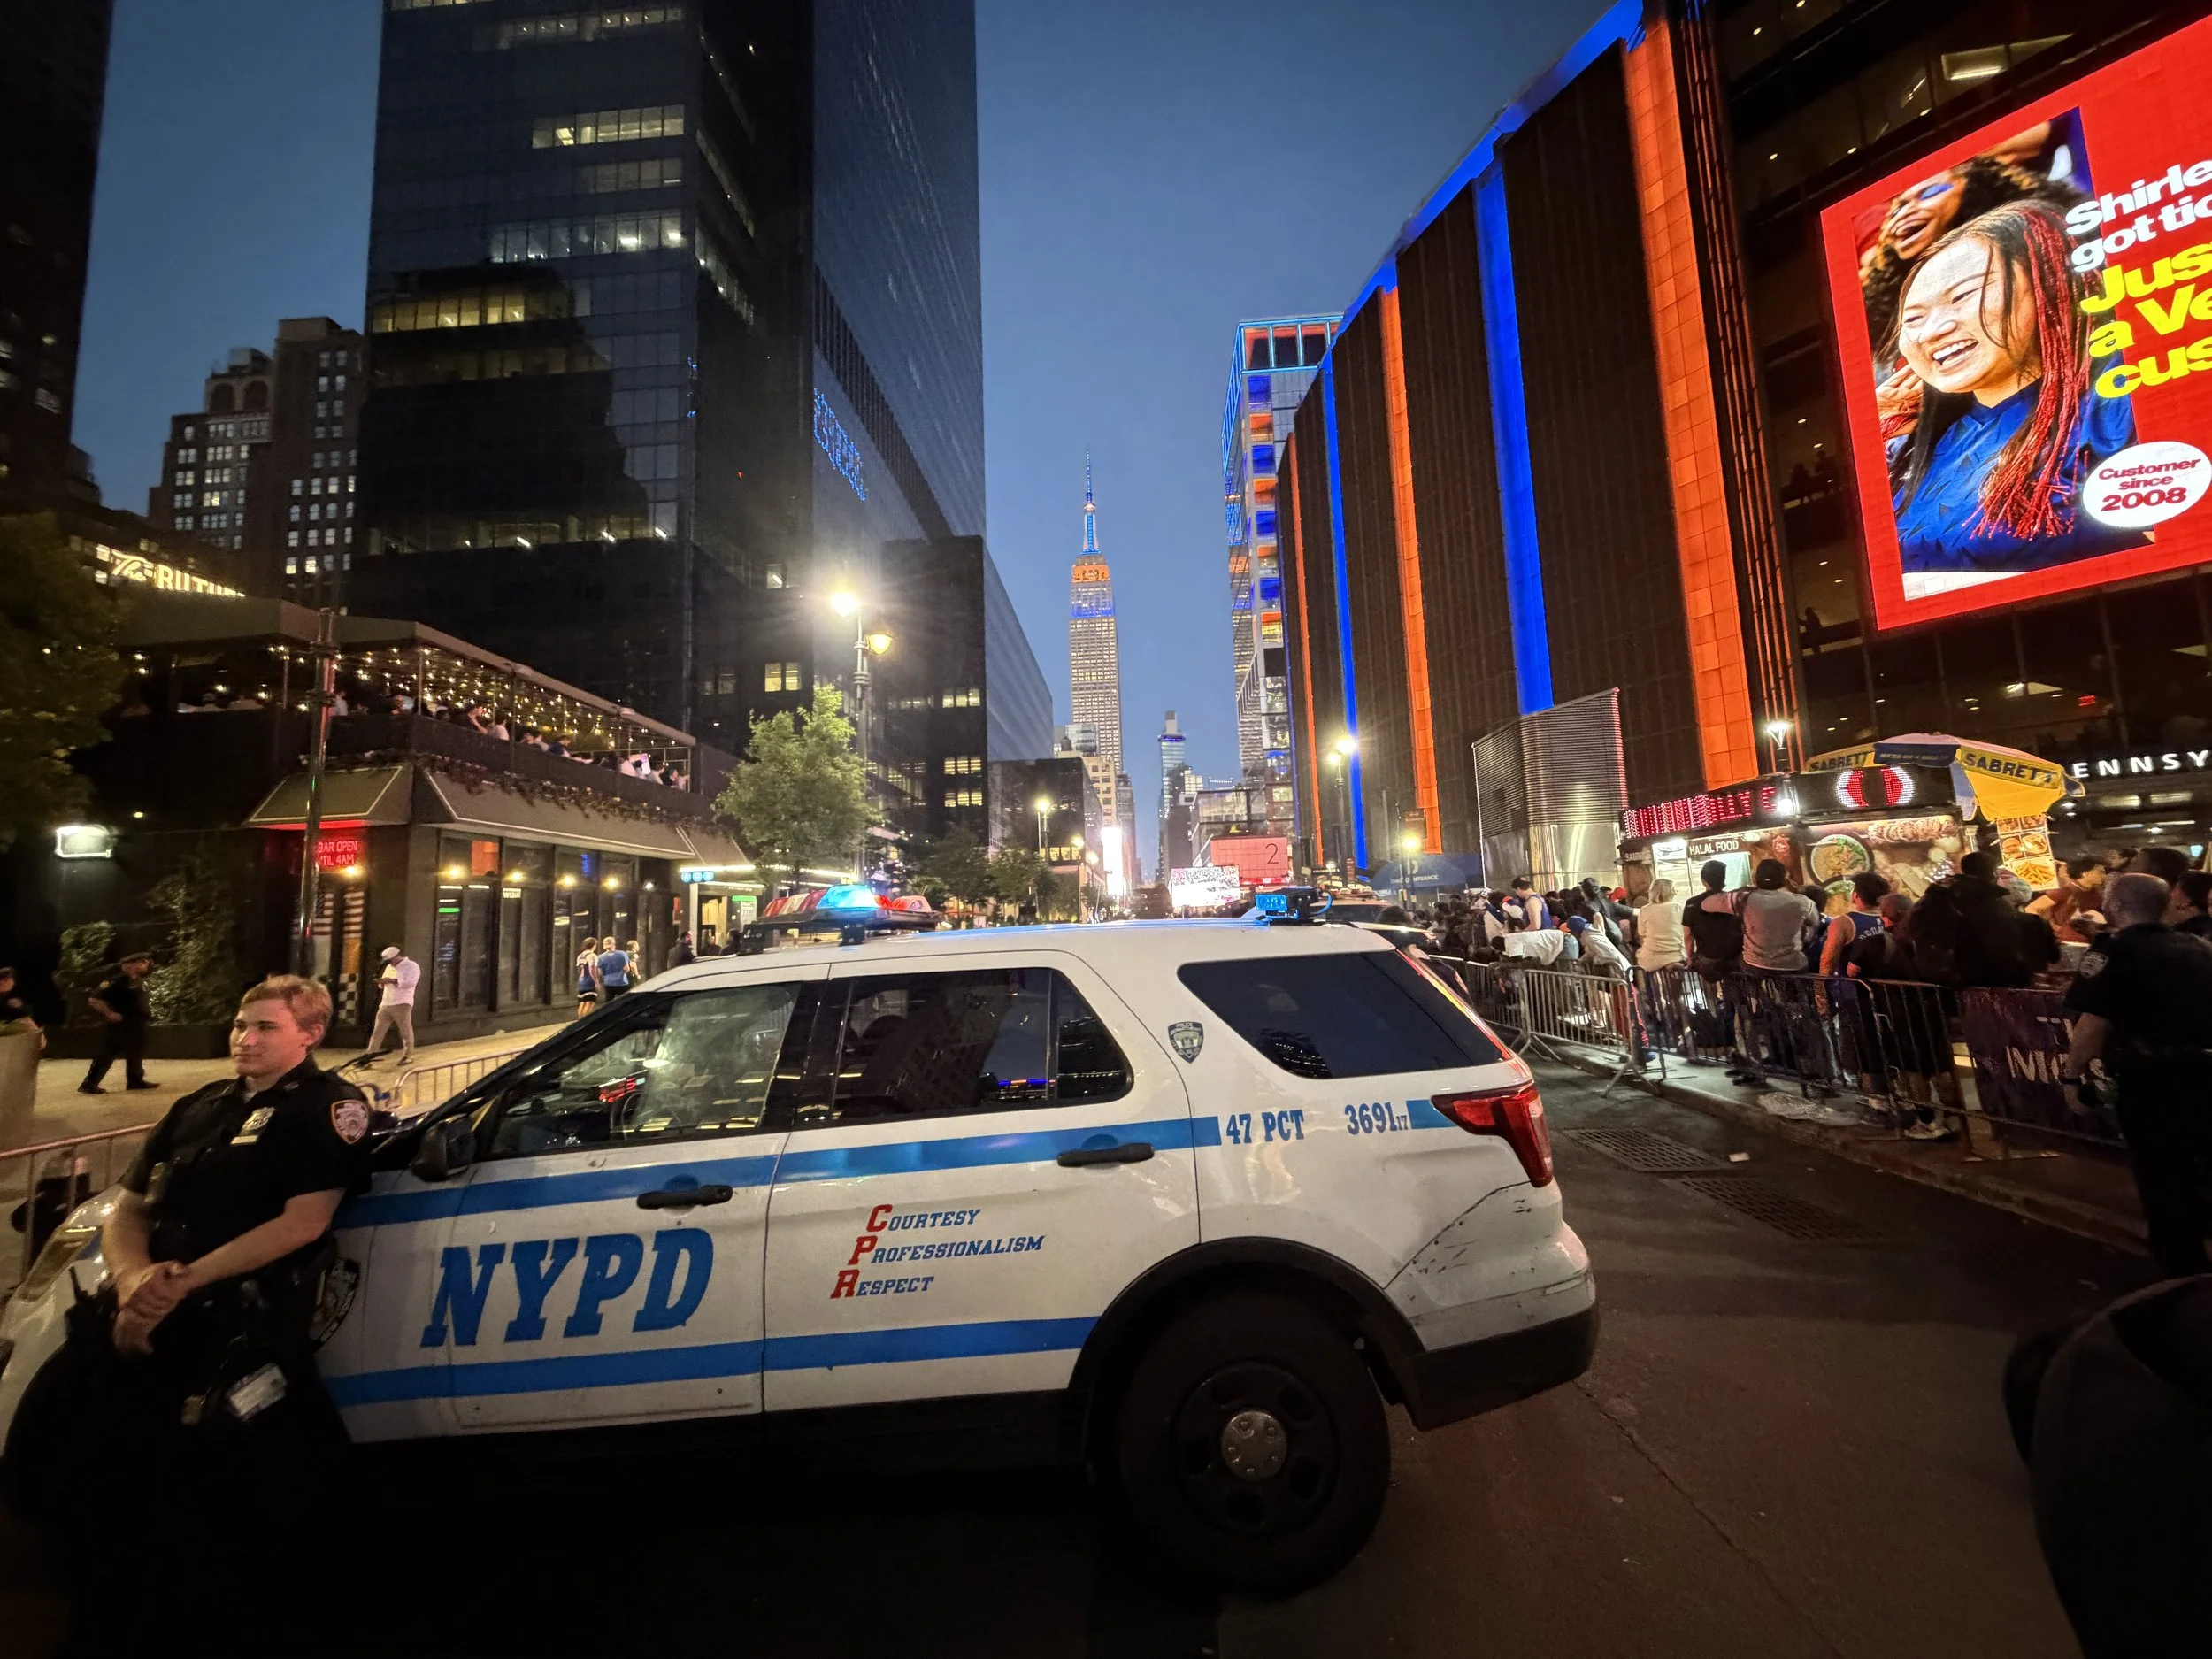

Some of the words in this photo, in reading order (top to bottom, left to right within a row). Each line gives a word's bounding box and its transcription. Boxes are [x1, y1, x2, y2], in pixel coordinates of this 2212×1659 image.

[2071, 214, 2157, 272] got
[2088, 321, 2136, 357] a
[2099, 458, 2201, 480] Customer
[2118, 476, 2174, 490] since
[2101, 487, 2187, 511] 2008
[1810, 750, 1869, 772] SABRETT
[1962, 752, 2057, 784] SABRETT
[318, 841, 335, 854] BAR
[337, 840, 358, 852] OPEN
[320, 855, 334, 866] 'TIL
[336, 854, 355, 864] 4AM
[1265, 842, 1279, 864] 2
[1689, 842, 1715, 856] HALAL
[1716, 840, 1740, 852] FOOD
[1226, 1113, 1252, 1144] 47
[1262, 1110, 1304, 1141] PCT
[1344, 1102, 1397, 1135] 3691
[865, 1204, 981, 1233] COURTESY
[848, 1235, 1046, 1266] PROFESSIONALISM
[419, 1228, 714, 1348] NYPD
[829, 1269, 934, 1299] RESPECT
